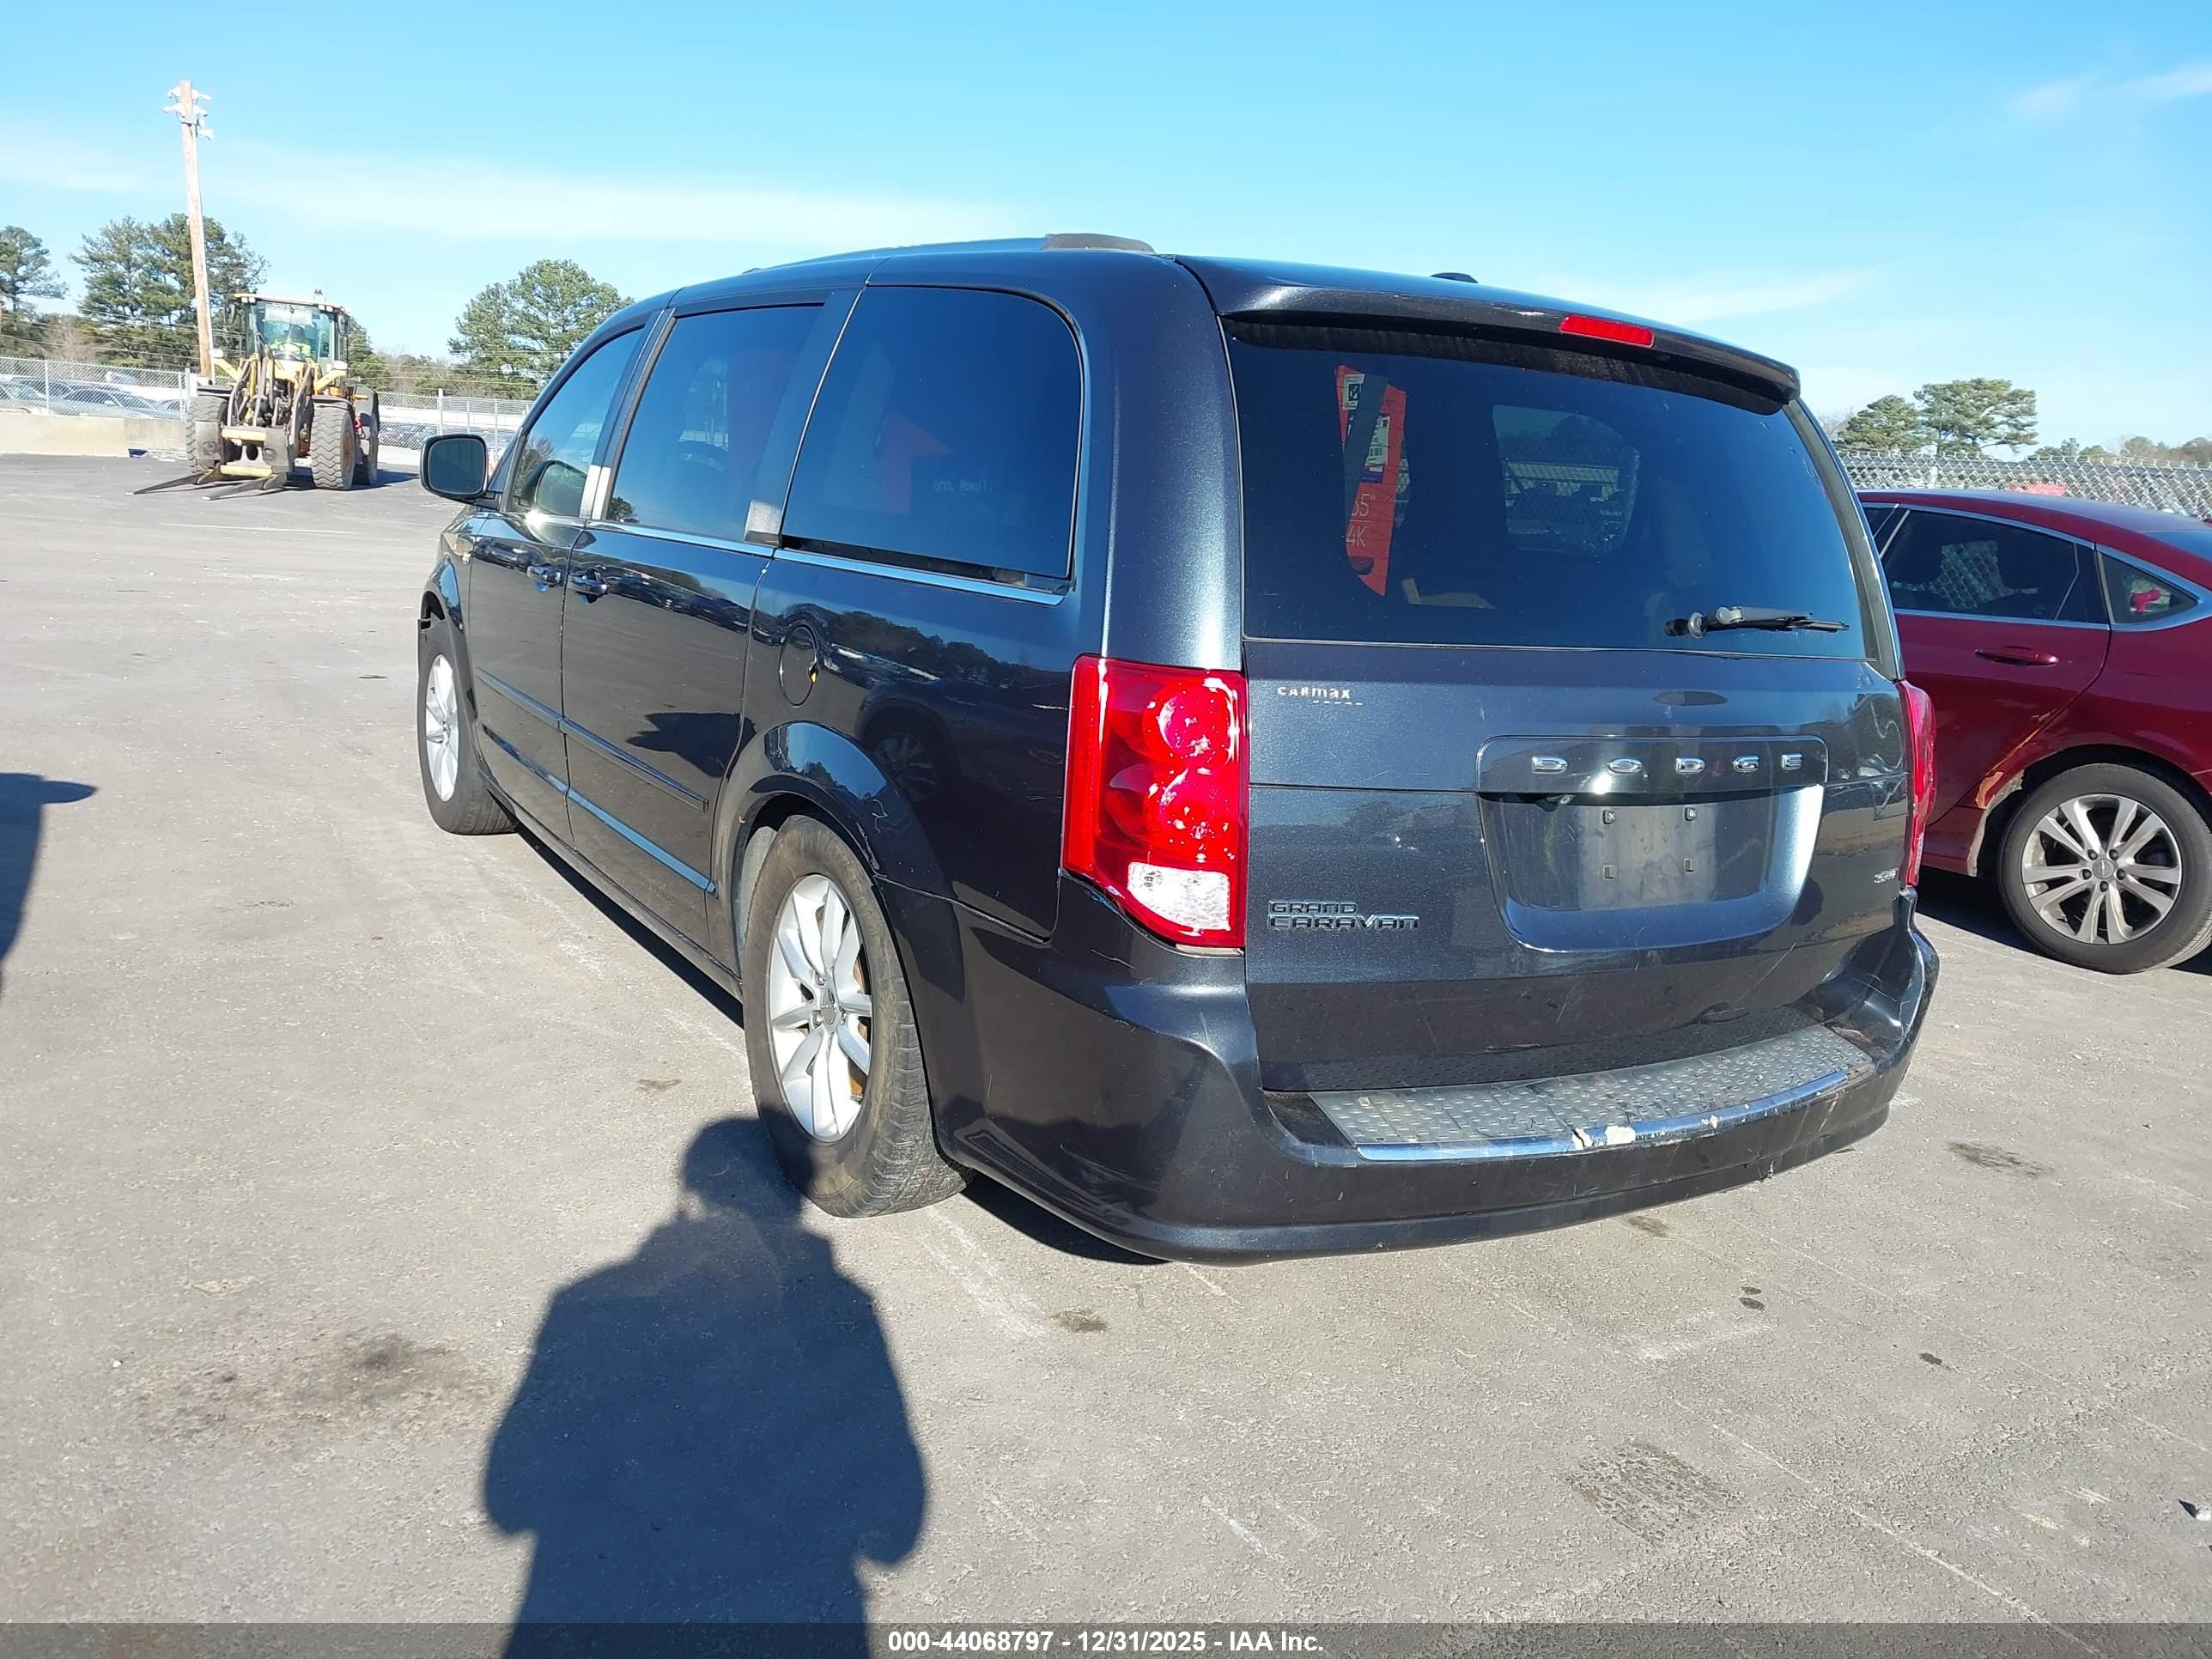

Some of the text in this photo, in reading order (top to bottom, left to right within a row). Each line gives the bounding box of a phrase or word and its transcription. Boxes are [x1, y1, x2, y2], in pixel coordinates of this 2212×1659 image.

[1346, 525, 1368, 548] 4K
[1531, 753, 1802, 775] DODGE
[1268, 900, 1358, 915] GRAND
[1267, 914, 1420, 930] CARAVAN
